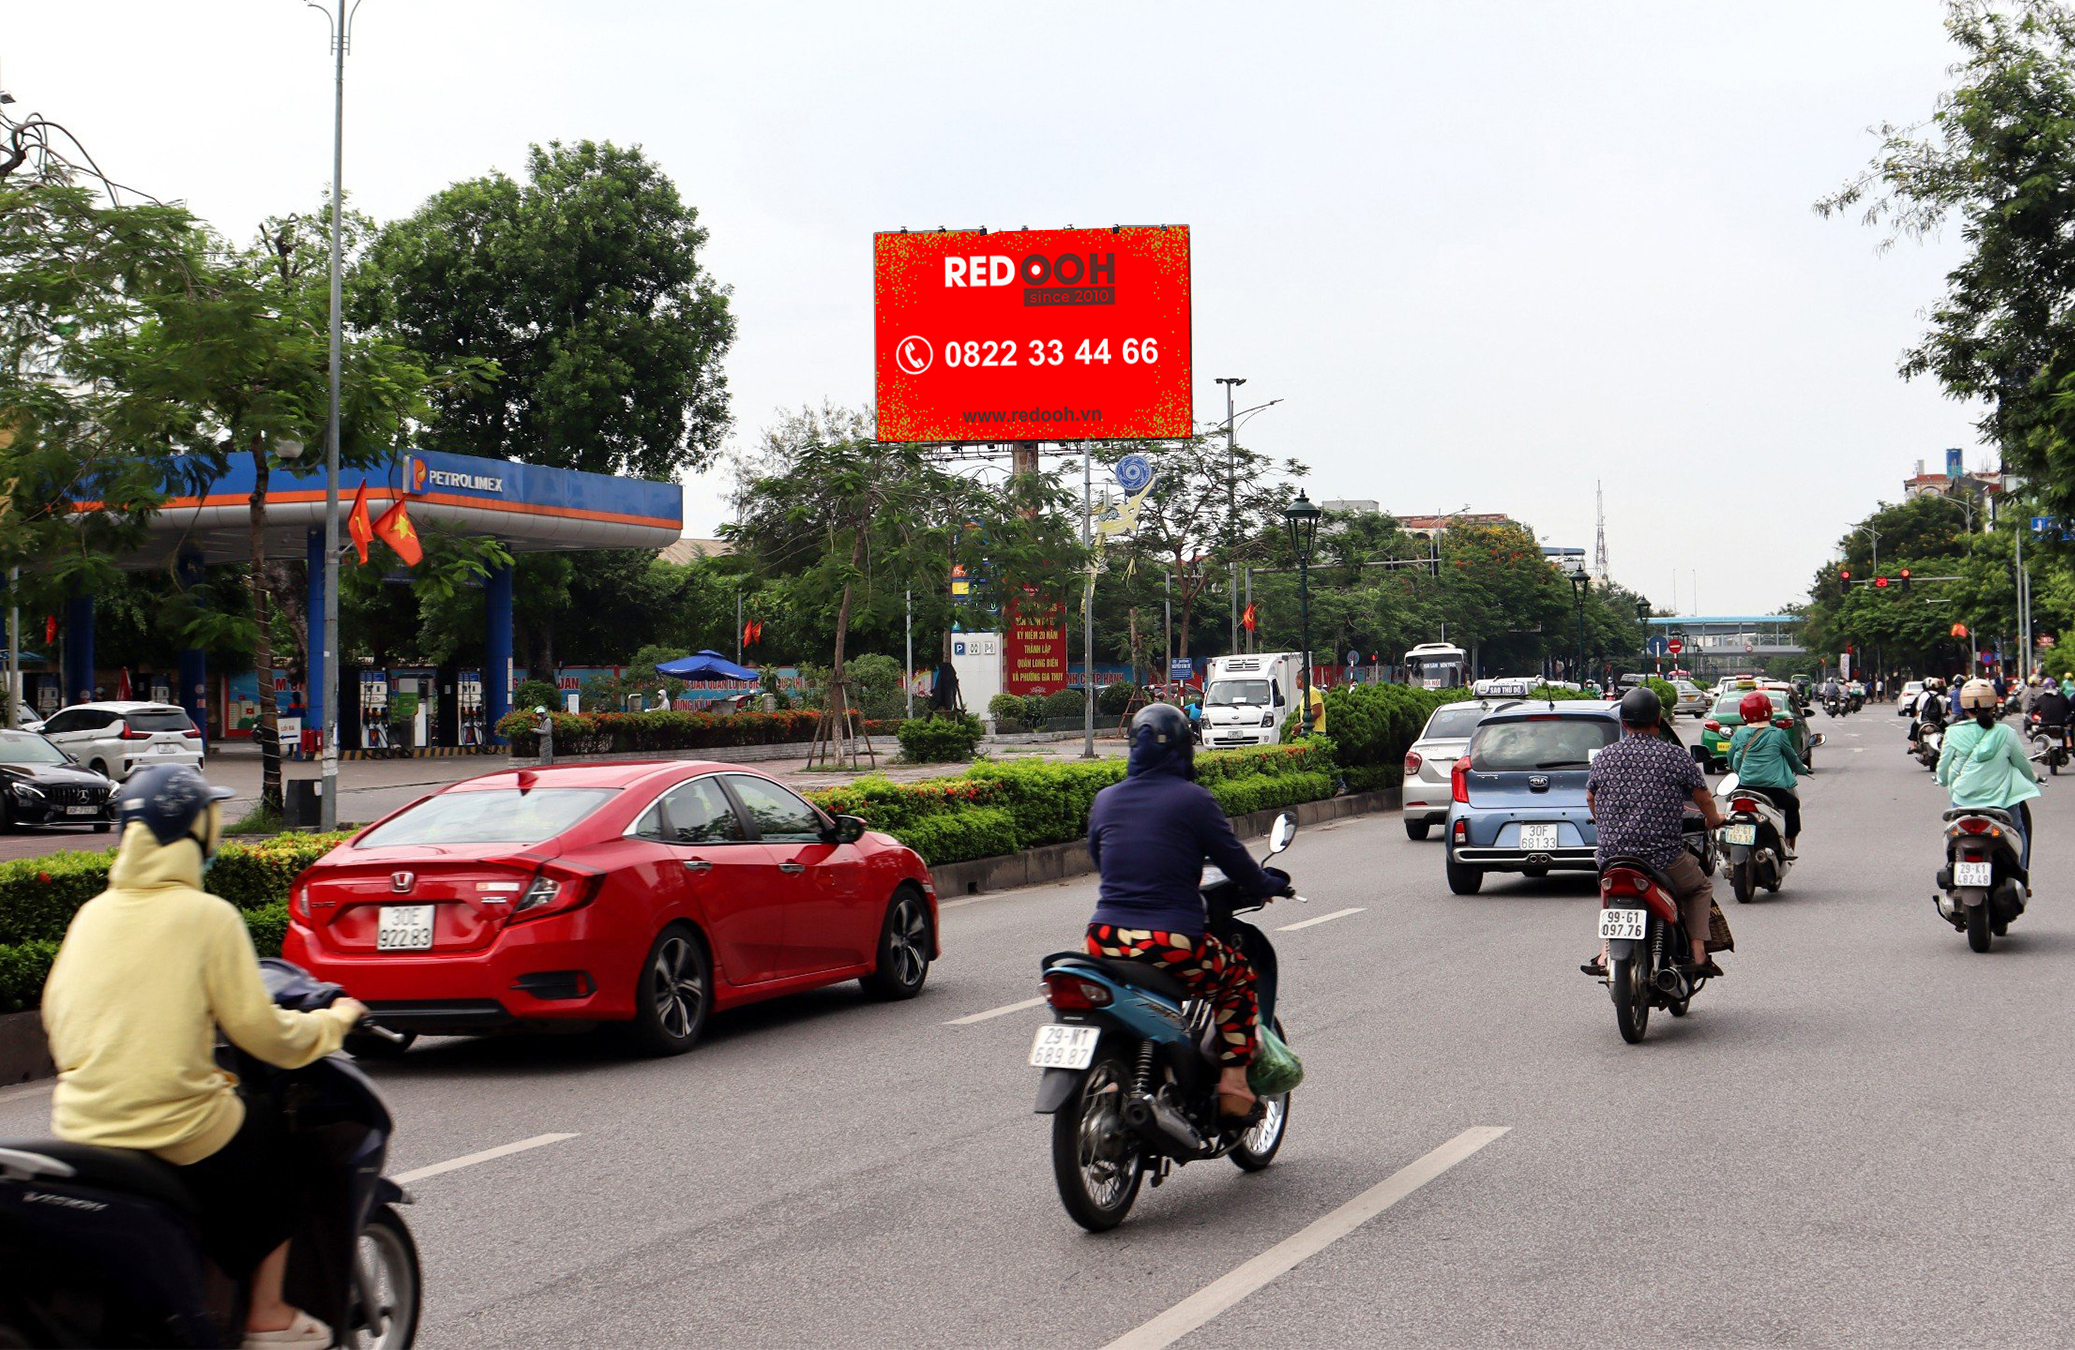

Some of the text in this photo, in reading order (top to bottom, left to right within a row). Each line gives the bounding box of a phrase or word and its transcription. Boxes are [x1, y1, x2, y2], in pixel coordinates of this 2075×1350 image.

[944, 252, 1116, 288] RED OOH
[1029, 289, 1109, 304] since 2010
[944, 337, 1159, 368] 0822 33 44 66
[962, 406, 1102, 424] www.redooh.vn
[429, 470, 503, 493] PETROLIMEX
[1032, 658, 1046, 668] LONG
[1529, 826, 1548, 837] 30F
[1521, 837, 1557, 849] 681.33
[392, 907, 420, 926] 30E
[1607, 911, 1639, 923] 99-G1
[1602, 924, 1642, 937] 097.76
[1034, 1046, 1089, 1065] 689.87
